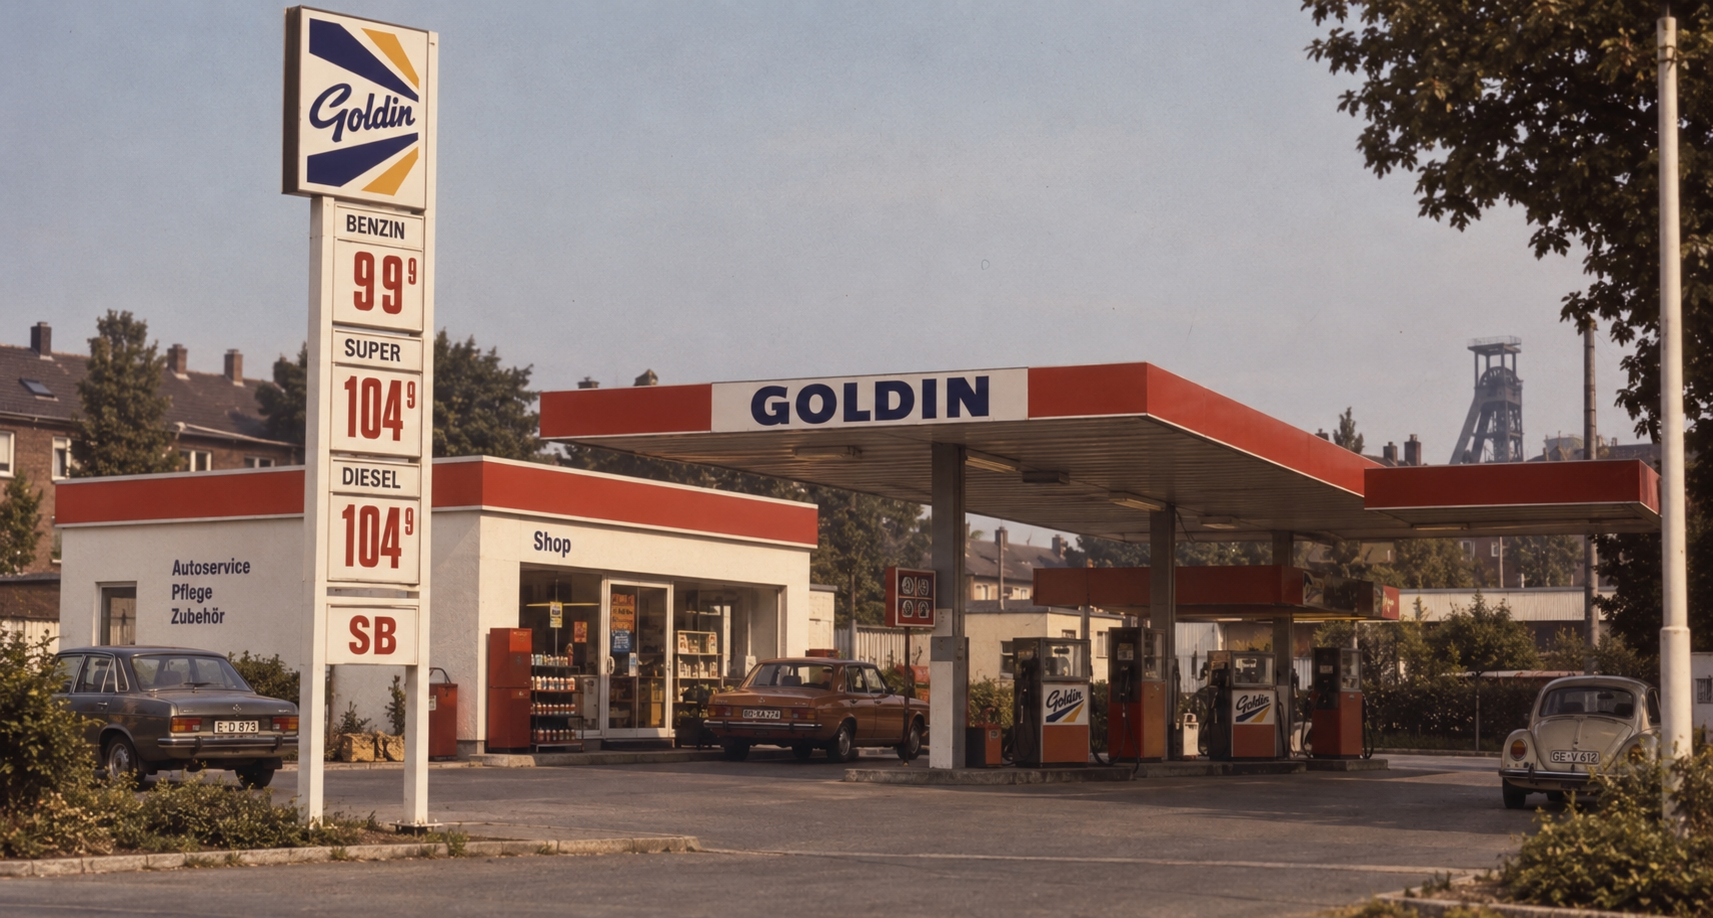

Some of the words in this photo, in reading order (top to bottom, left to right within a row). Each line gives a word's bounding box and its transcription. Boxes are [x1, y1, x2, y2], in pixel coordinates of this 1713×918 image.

[309, 83, 416, 143] Goldin
[346, 214, 405, 240] BENZIN
[344, 338, 401, 362] SUPER
[750, 376, 990, 426] GOLDIN
[342, 467, 401, 489] DIESEL
[533, 530, 572, 558] Shop
[172, 558, 251, 576] Autoservice
[172, 583, 213, 603] Pflege
[171, 607, 225, 625] Zubehör
[349, 615, 397, 655] SB
[238, 722, 256, 732] 873
[1580, 752, 1598, 763] 612
